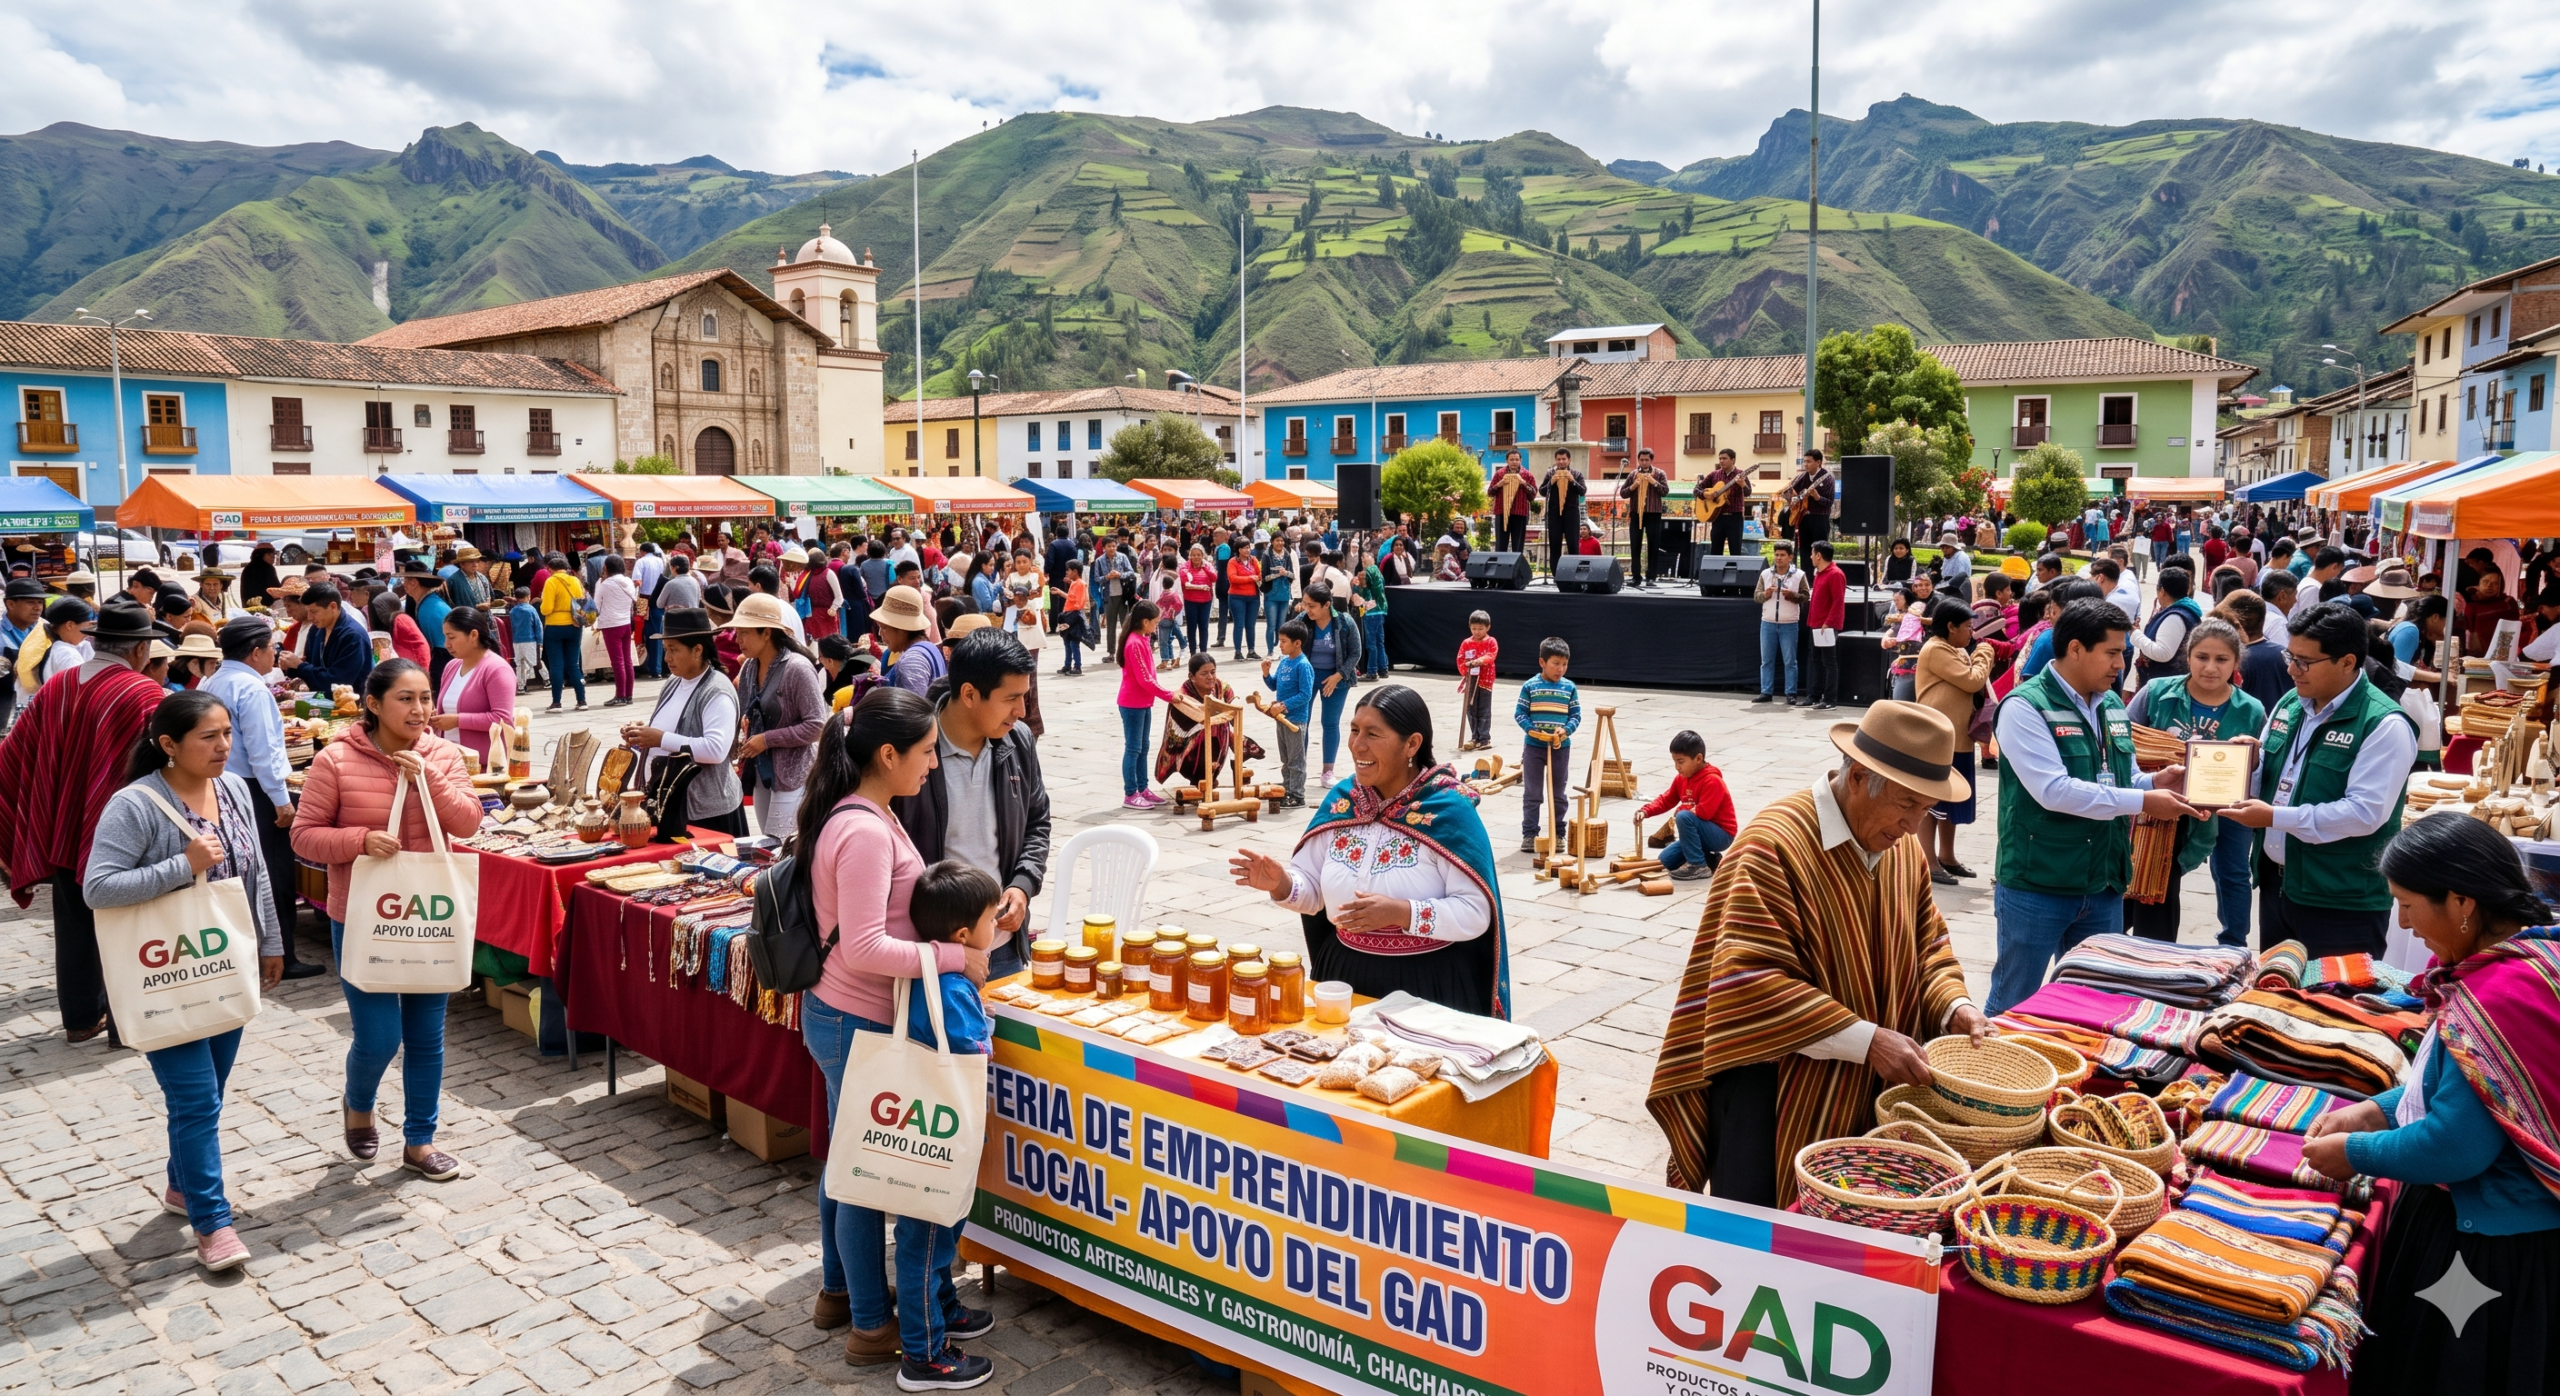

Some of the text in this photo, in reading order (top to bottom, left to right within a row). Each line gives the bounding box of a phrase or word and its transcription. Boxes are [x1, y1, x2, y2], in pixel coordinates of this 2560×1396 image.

[213, 514, 241, 524] GAD
[2325, 730, 2354, 745] GAD
[376, 892, 455, 921] GAD
[138, 927, 229, 969] GAD
[373, 924, 455, 938] APOYO LOCAL
[142, 958, 236, 989] APOYO LOCAL
[870, 1091, 960, 1140] GAD
[862, 1129, 954, 1163] APOYO LOCAL
[1084, 1096, 1132, 1161] DE
[1143, 1116, 1569, 1300] EMPRENDIMIENTO
[1004, 1133, 1484, 1353] LOCAL- APOYO DEL GAD
[994, 1205, 1081, 1258] PRODUCTOS
[1084, 1243, 1200, 1307] ARTESANALES
[1203, 1289, 1217, 1313] Y
[1221, 1297, 1361, 1374] GASTRONOMÍA,
[1648, 1264, 1892, 1396] GAD
[1647, 1361, 1738, 1396] PRODUCTOS
[1666, 1382, 1676, 1395] Y
